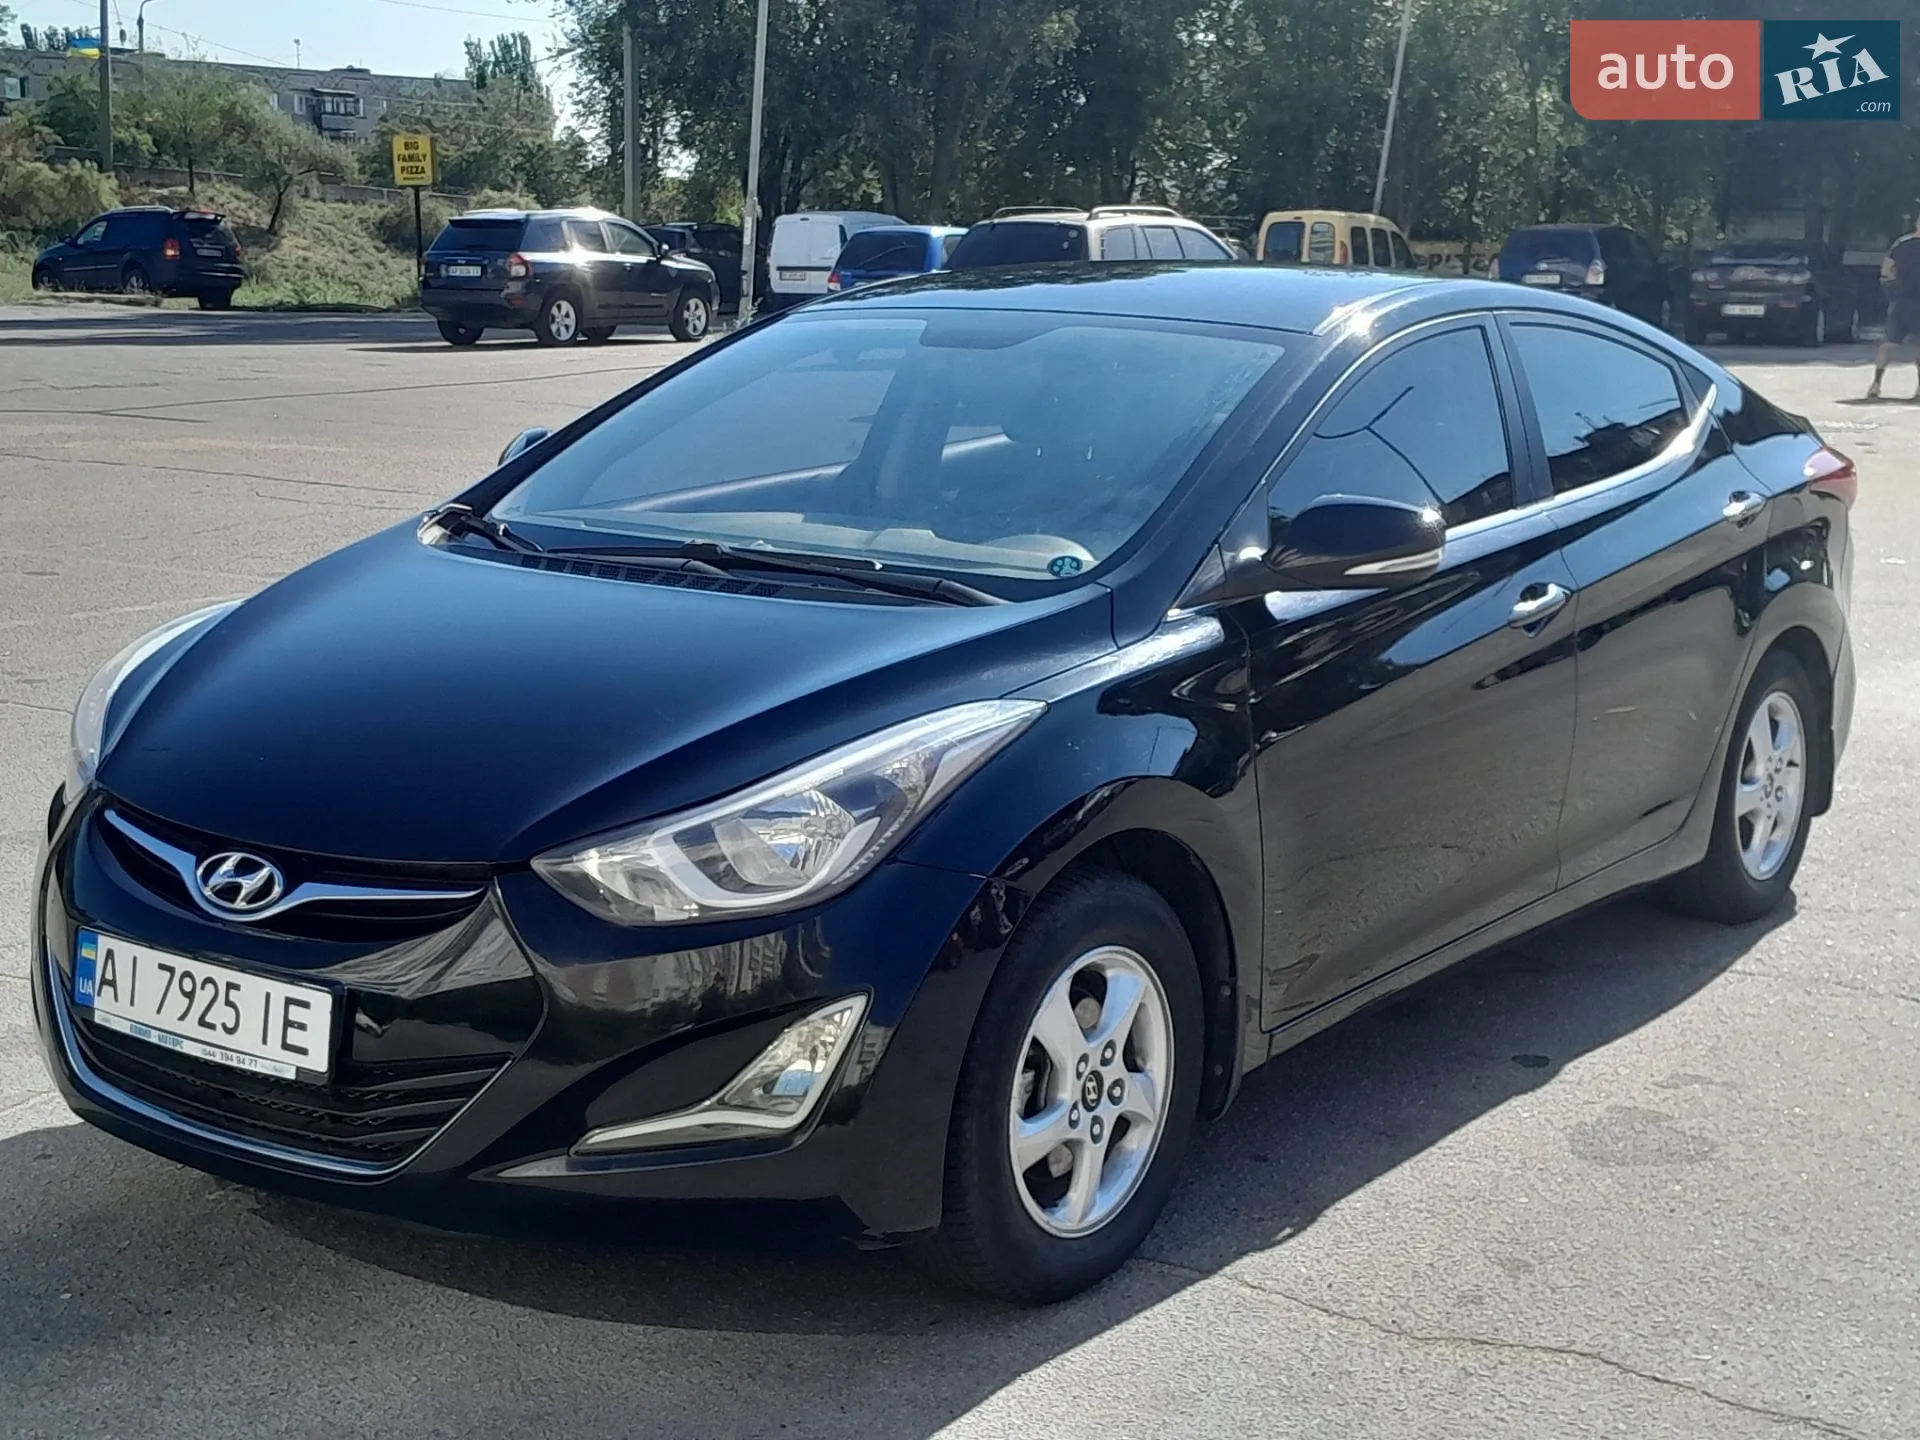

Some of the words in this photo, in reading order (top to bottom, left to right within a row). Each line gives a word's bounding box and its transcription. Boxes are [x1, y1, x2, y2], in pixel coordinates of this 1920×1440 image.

[403, 141, 419, 151] BIG
[397, 153, 427, 162] FAMILY
[400, 165, 426, 174] PIZZA
[79, 977, 94, 996] UA
[97, 948, 138, 1008] AI
[156, 962, 241, 1036] 7925
[261, 991, 312, 1056] IE
